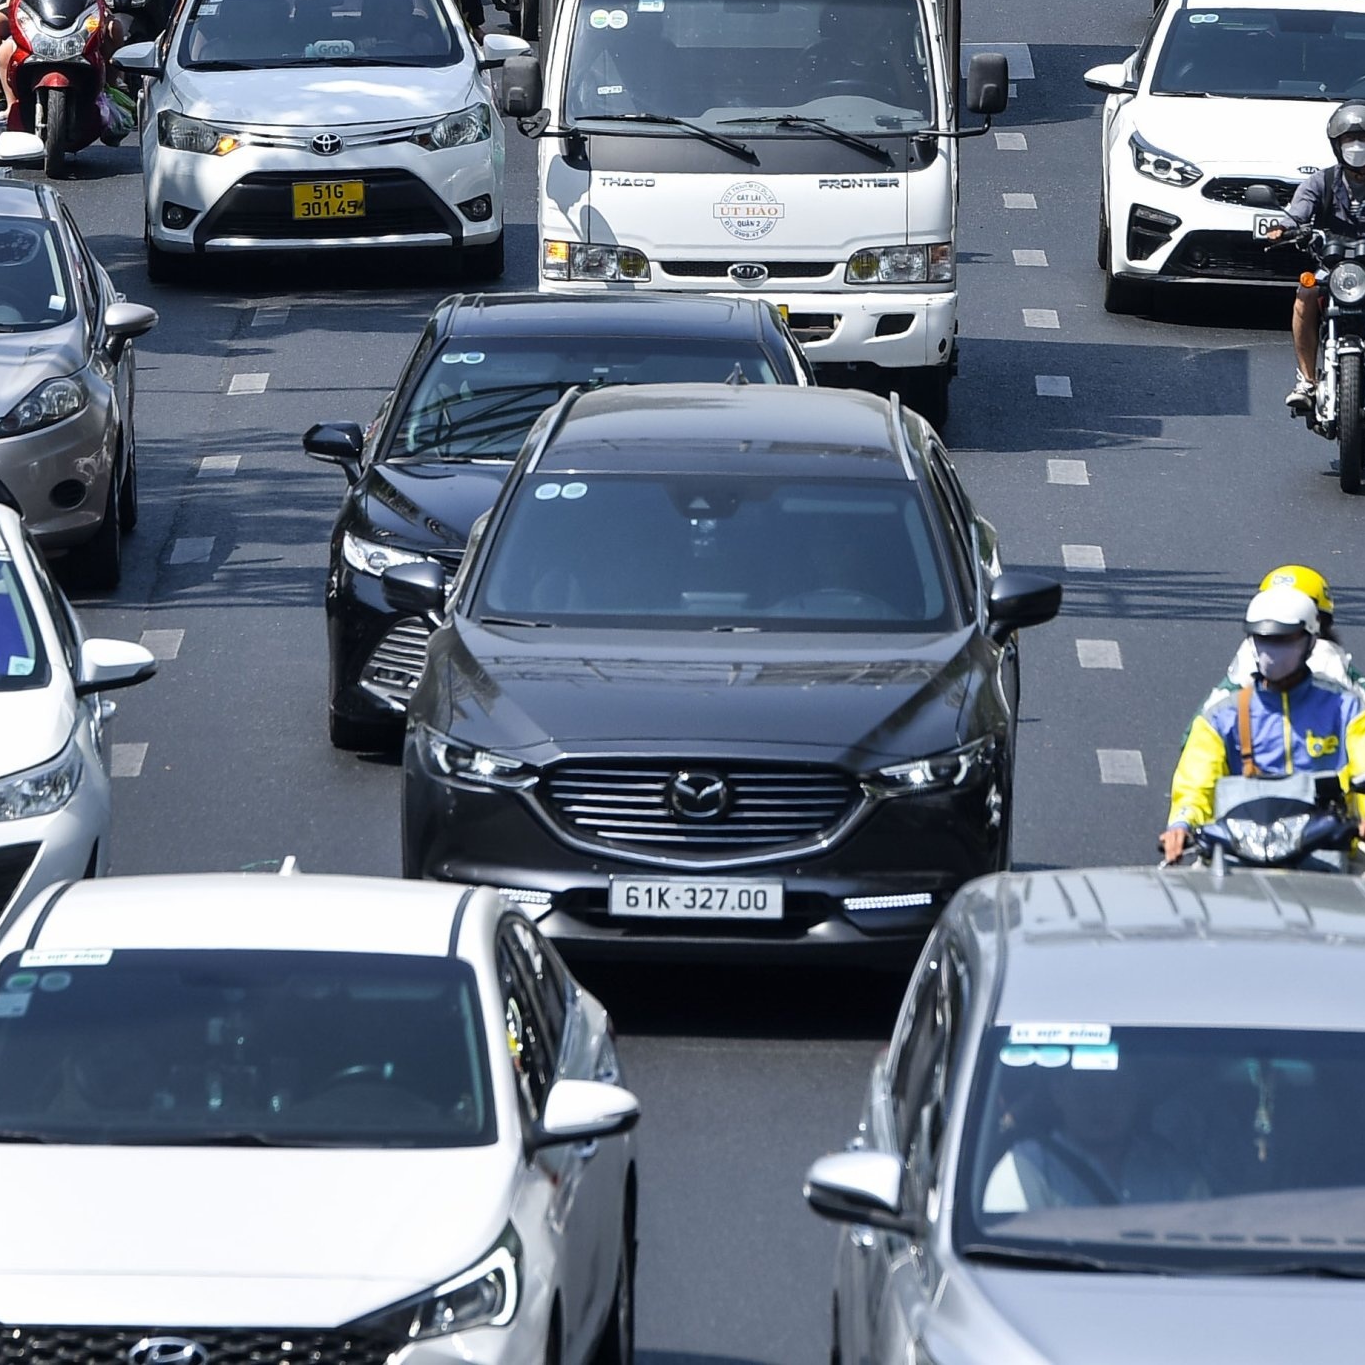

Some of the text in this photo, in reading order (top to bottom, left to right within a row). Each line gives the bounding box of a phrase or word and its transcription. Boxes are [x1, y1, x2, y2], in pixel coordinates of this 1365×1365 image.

[599, 177, 900, 189] THACO FRONTIER
[313, 184, 344, 199] 51G
[302, 201, 357, 216] 301.45
[736, 267, 759, 277] KIA
[1306, 729, 1340, 759] be
[624, 886, 768, 911] 61K-327.00
